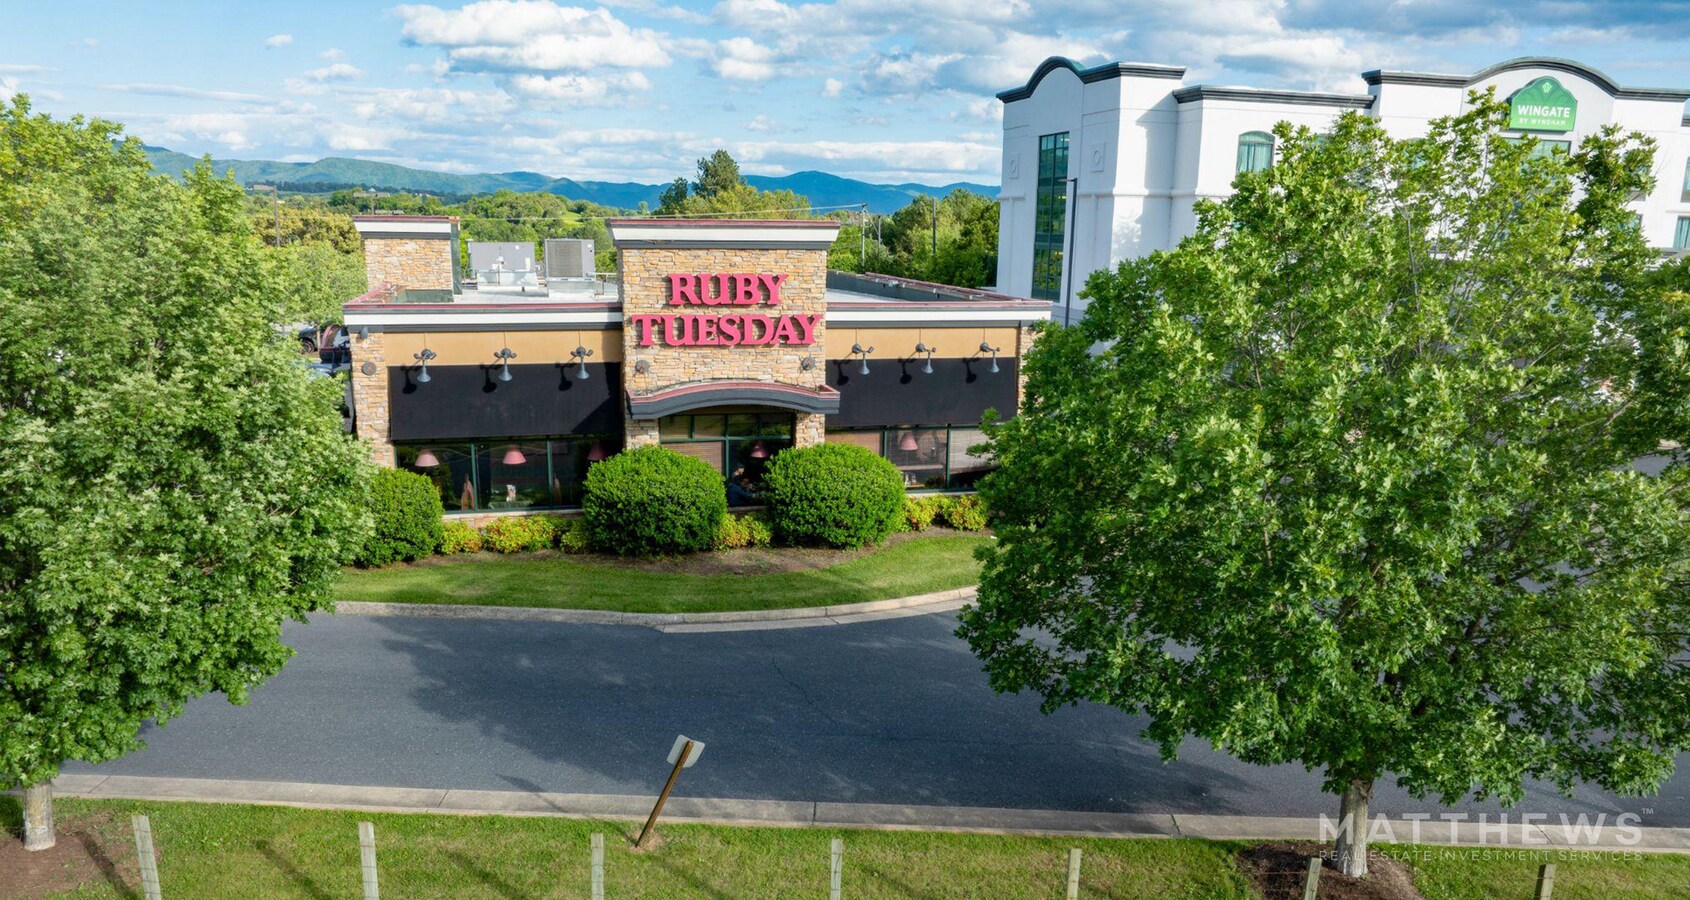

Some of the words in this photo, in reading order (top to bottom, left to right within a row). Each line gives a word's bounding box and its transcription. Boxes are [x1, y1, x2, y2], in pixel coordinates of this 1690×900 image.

[1518, 105, 1571, 118] WINGATE
[1531, 118, 1566, 126] WYNDHAM
[667, 273, 789, 306] RUBY
[631, 313, 823, 346] TUESDAY
